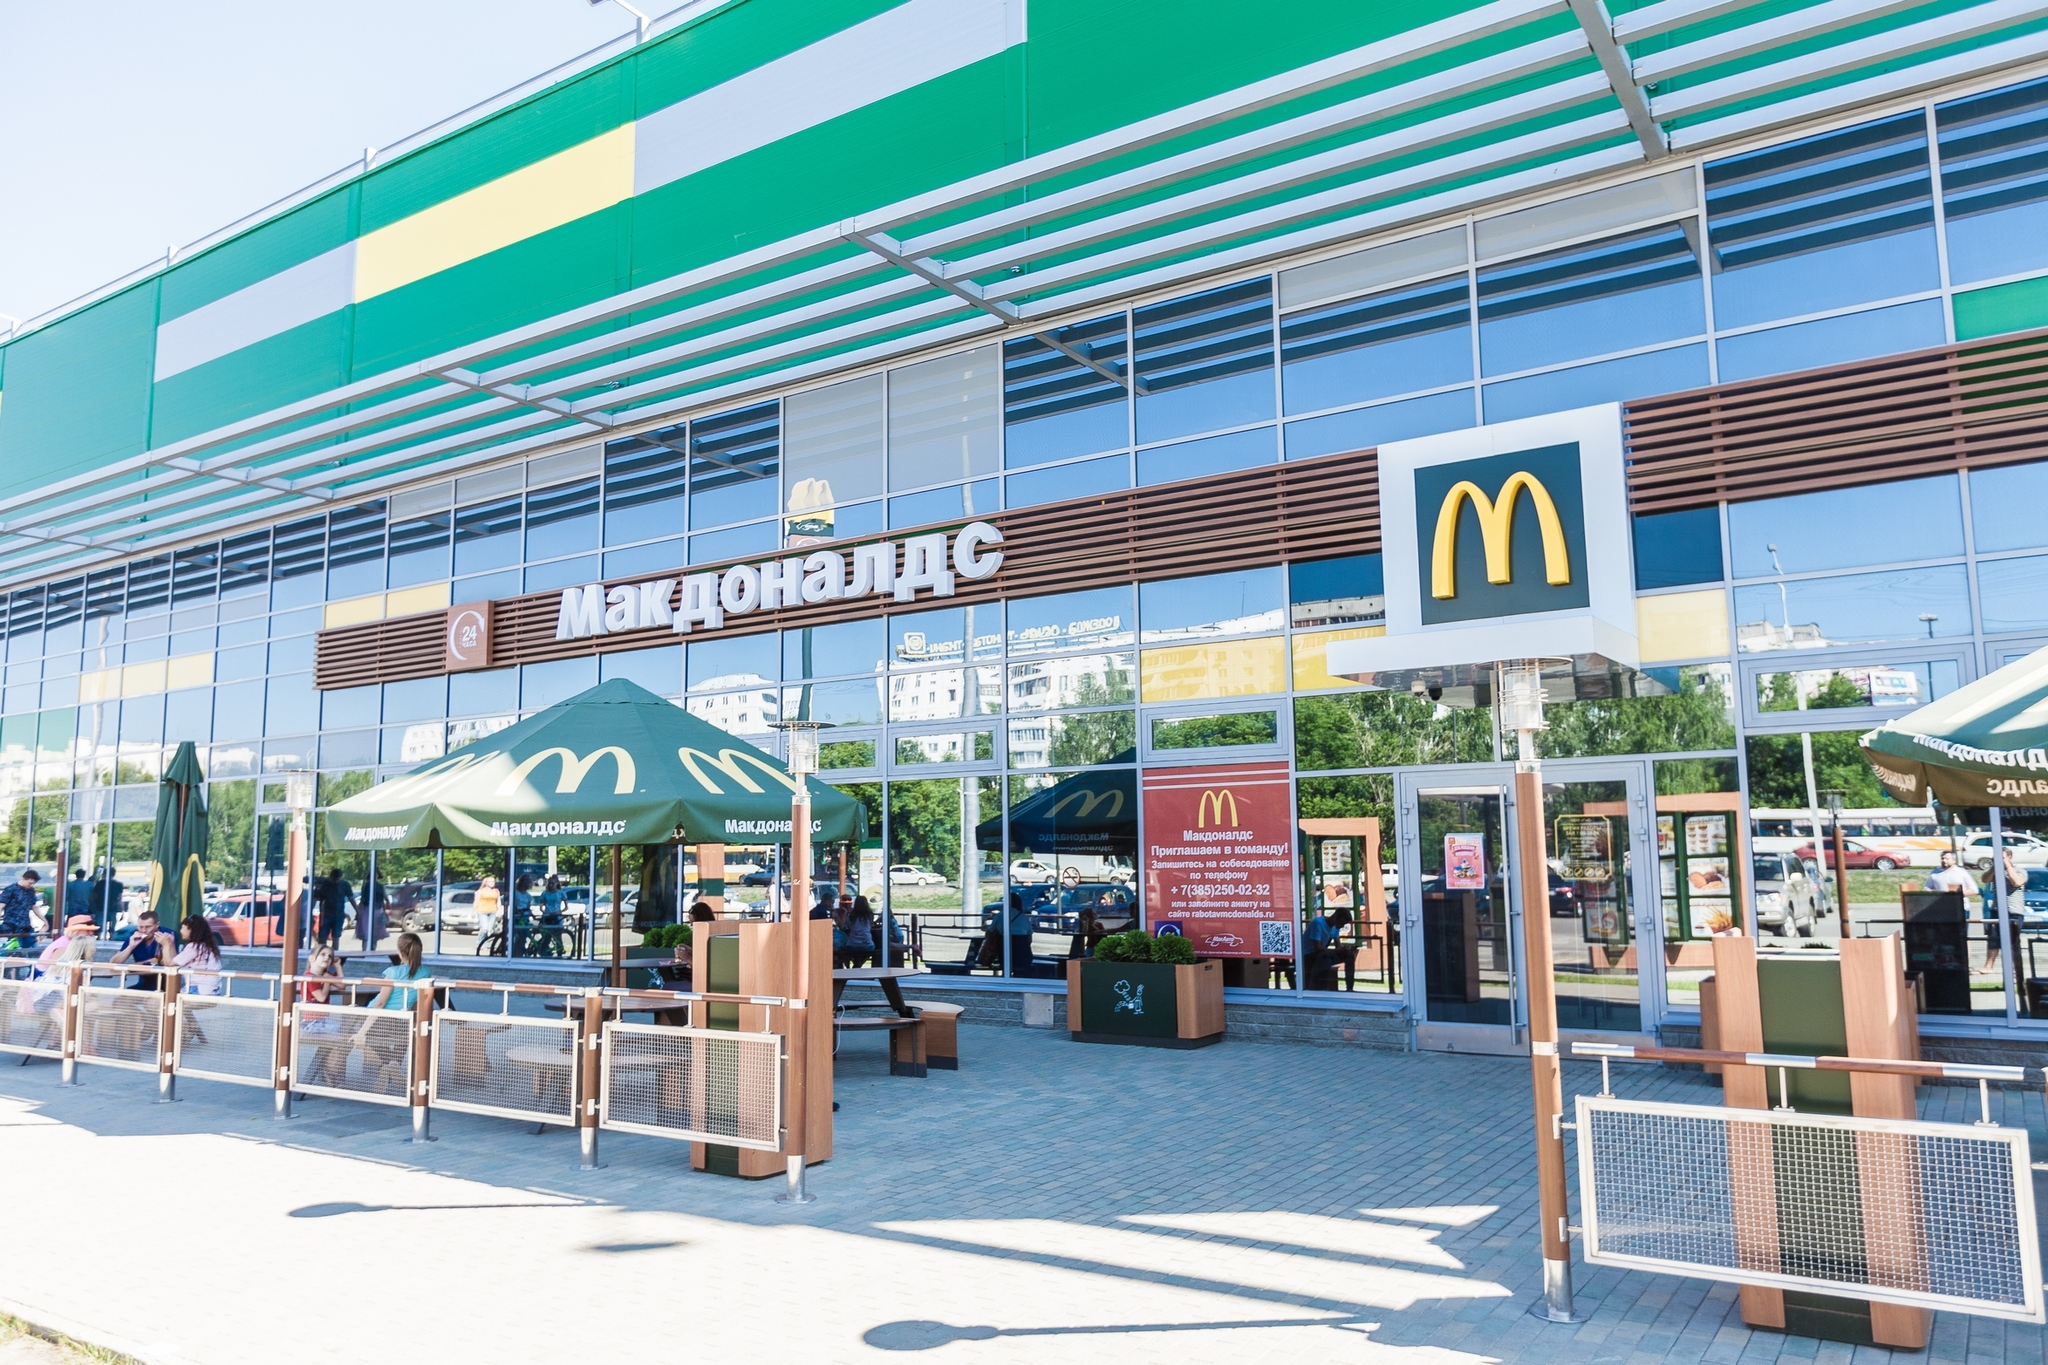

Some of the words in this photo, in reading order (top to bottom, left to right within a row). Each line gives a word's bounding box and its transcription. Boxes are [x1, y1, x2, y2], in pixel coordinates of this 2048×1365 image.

[555, 521, 1005, 640] Макдоналдс
[462, 625, 477, 641] 24
[345, 824, 409, 842] Макдоналдс
[490, 819, 627, 837] Макдоналдс
[725, 818, 822, 834] Макдонас
[1183, 830, 1254, 842] Макдоналдс
[1151, 845, 1221, 858] Приглашаем
[1224, 846, 1232, 855] в
[1234, 842, 1289, 857] команду!
[1151, 860, 1204, 869] Запишитесь
[1219, 858, 1290, 869] собеседование
[1190, 872, 1201, 880] по
[1204, 870, 1248, 881] телефону
[1181, 884, 1270, 898] 7(385)250-02-32
[1188, 900, 1230, 909] заполните
[1231, 901, 1258, 909] анкету
[1168, 910, 1190, 918] сайте
[1191, 910, 1275, 919] rabotavmcdonalds.ru
